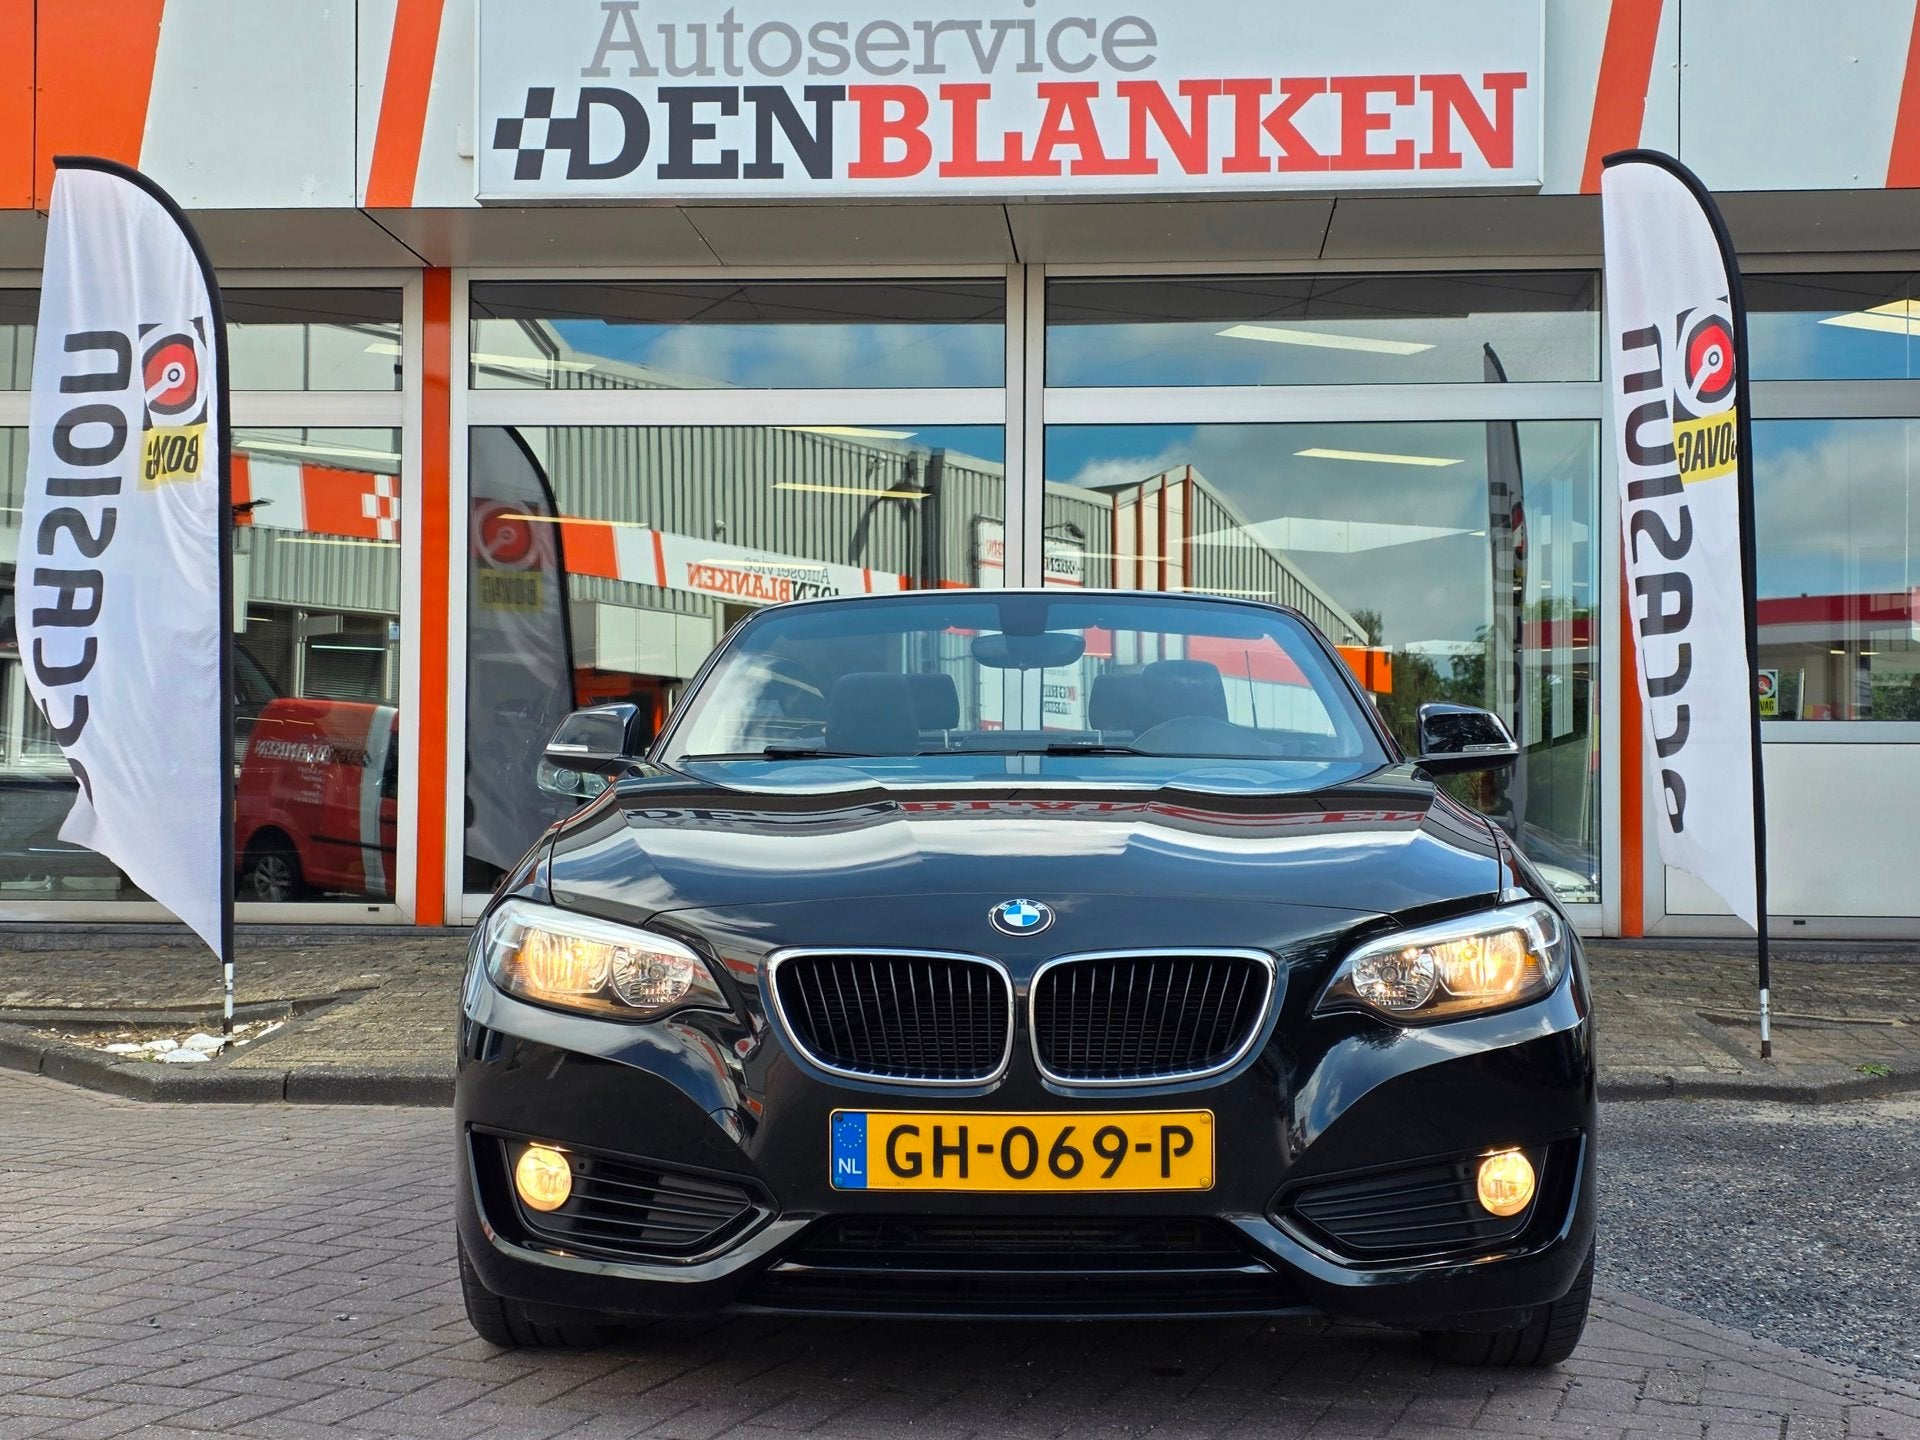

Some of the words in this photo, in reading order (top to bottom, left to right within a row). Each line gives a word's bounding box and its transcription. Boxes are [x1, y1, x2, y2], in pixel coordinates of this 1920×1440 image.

[580, 0, 1158, 77] Autoservice
[1760, 700, 1774, 711] VAG
[838, 1157, 862, 1174] NL
[885, 1124, 1194, 1179] GH-069-P
